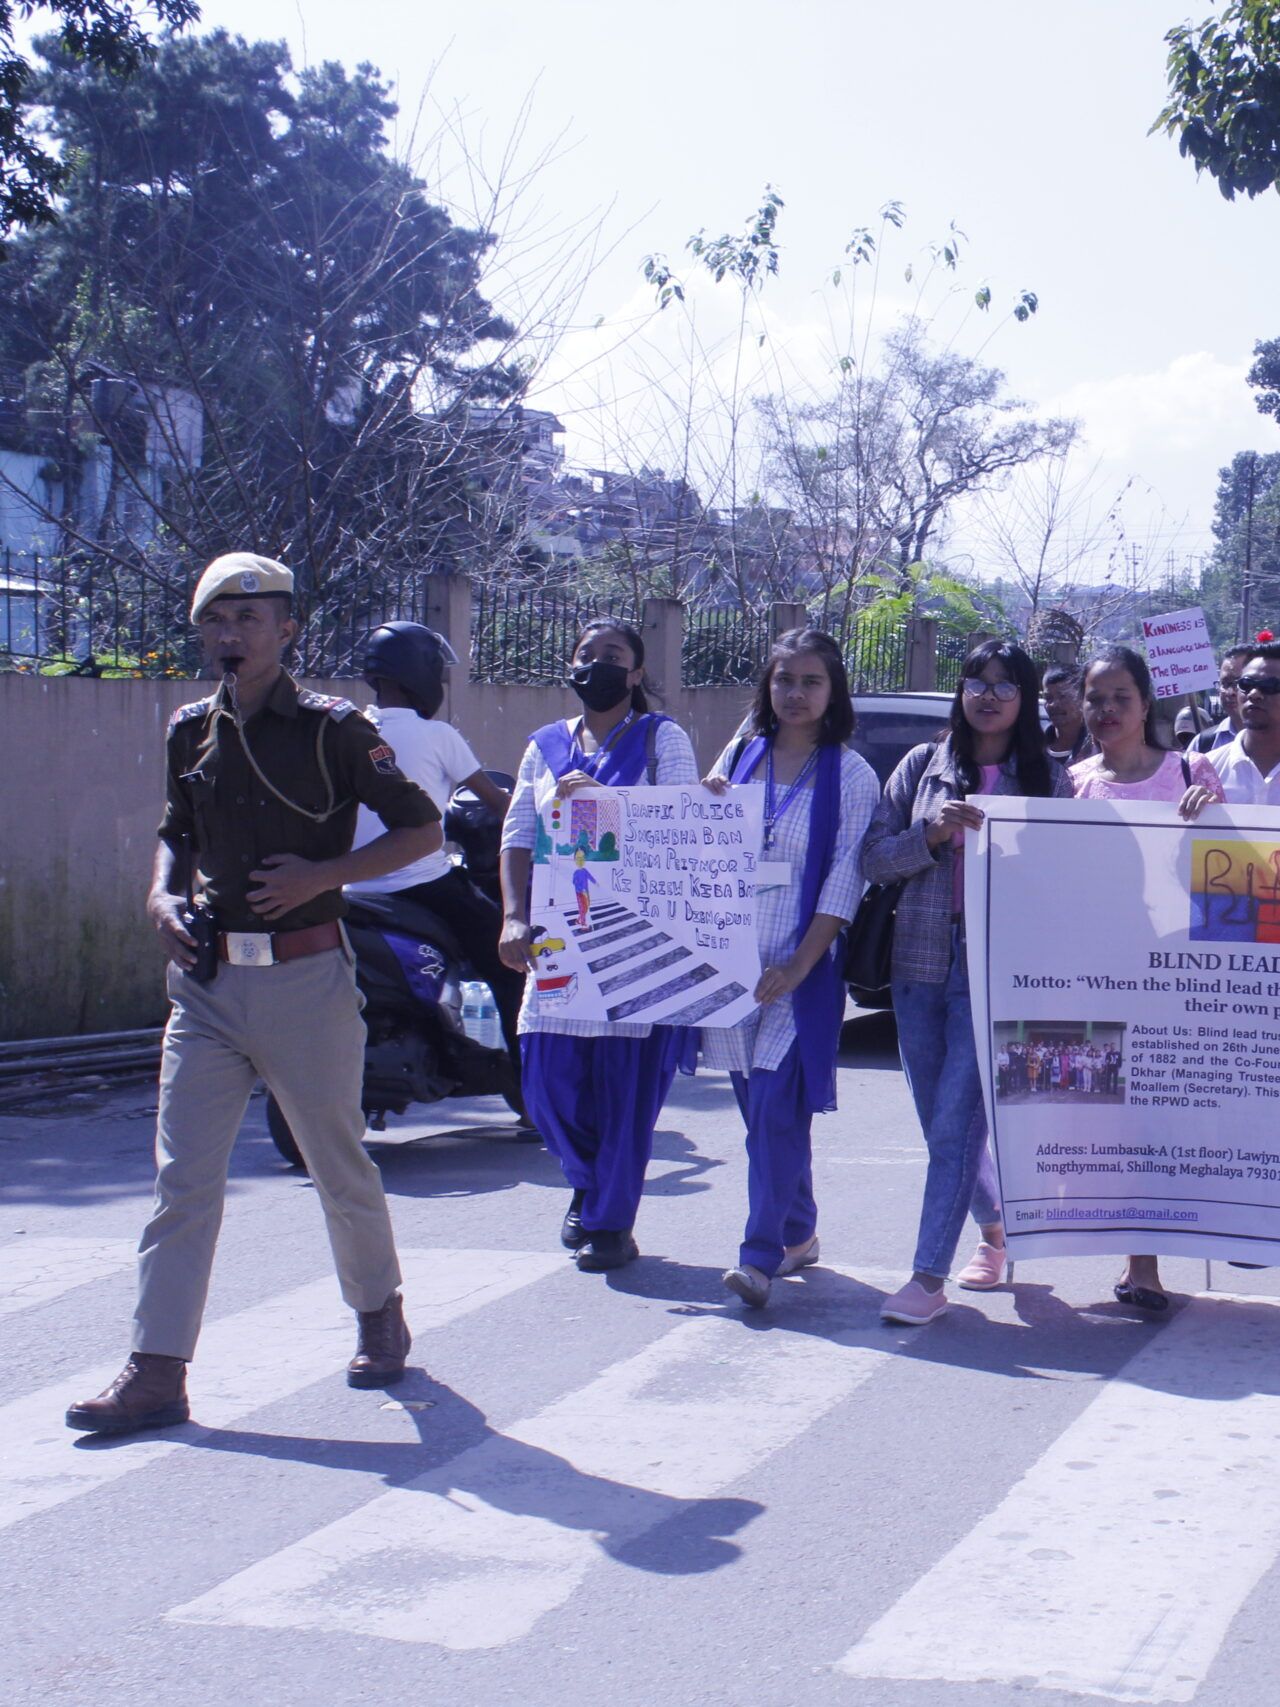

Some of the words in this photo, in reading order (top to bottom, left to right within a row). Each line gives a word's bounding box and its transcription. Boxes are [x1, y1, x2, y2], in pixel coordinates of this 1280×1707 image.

[1143, 620, 1192, 637] KINDNESS
[1156, 684, 1180, 696] SEE
[617, 790, 675, 820] TRAFFIC
[681, 792, 744, 820] POLICE
[703, 826, 742, 845] BAN
[743, 852, 756, 872] I
[668, 900, 676, 920] U
[1149, 952, 1221, 970] BLIND
[1012, 974, 1071, 989] Motto:
[1076, 975, 1138, 990] “When
[1143, 978, 1171, 992] the
[1176, 977, 1221, 994] blind
[1226, 979, 1262, 996] lead
[1185, 998, 1228, 1013] their
[1232, 1004, 1268, 1016] own
[1132, 1024, 1168, 1036] About
[1173, 1026, 1192, 1037] Us:
[1198, 1026, 1228, 1038] Blind
[1233, 1028, 1257, 1039] lead
[1132, 1040, 1200, 1051] established
[1204, 1042, 1218, 1052] on
[1222, 1042, 1248, 1053] 26th
[1252, 1044, 1280, 1055] June
[1131, 1053, 1143, 1063] of
[1150, 1054, 1176, 1064] 1882
[1182, 1055, 1204, 1066] and
[1210, 1056, 1228, 1067] the
[1131, 1067, 1166, 1078] Dkhar
[1171, 1070, 1232, 1083] (Managing
[1130, 1082, 1180, 1093] Moallem
[1184, 1083, 1250, 1098] (Secretary).
[1256, 1087, 1280, 1098] This
[1130, 1096, 1148, 1106] the
[1152, 1096, 1189, 1106] RPWD
[1193, 1098, 1221, 1108] acts.
[1036, 1144, 1088, 1156] Address:
[1090, 1144, 1168, 1158] Lumbasuk-A
[1172, 1146, 1196, 1159] (1st
[1199, 1146, 1234, 1162] floor)
[1036, 1161, 1124, 1174] Nongthymmai,
[1127, 1161, 1176, 1176] Shillong
[1179, 1164, 1242, 1179] Meghalaya
[1016, 1209, 1044, 1221] Email:
[1046, 1208, 1198, 1221] blindleadtrust@gmail.com
